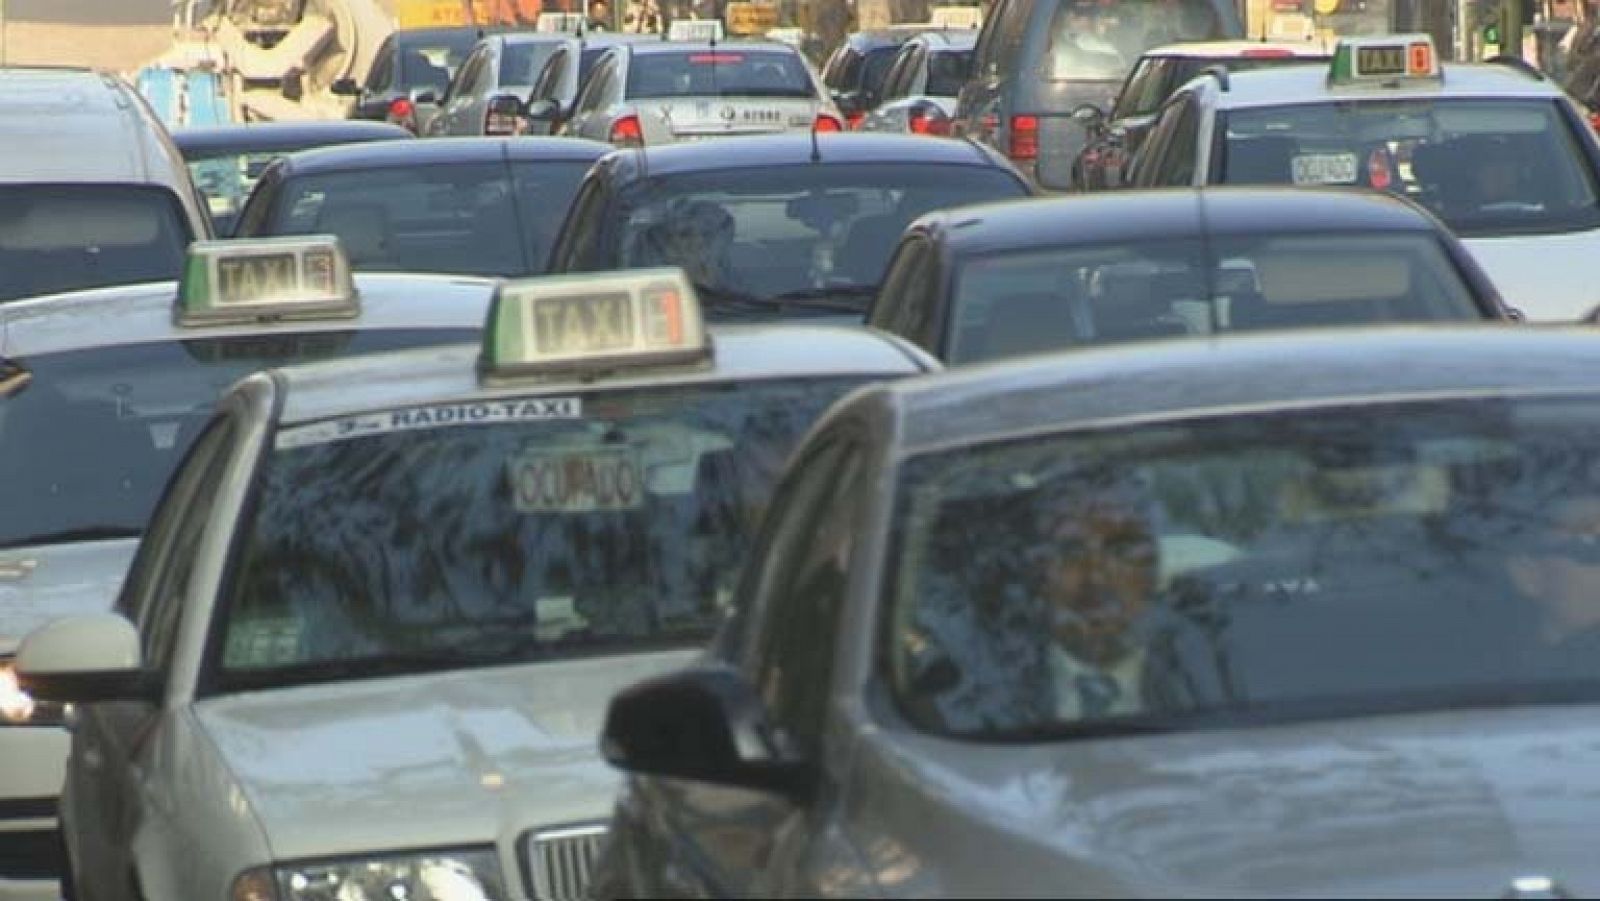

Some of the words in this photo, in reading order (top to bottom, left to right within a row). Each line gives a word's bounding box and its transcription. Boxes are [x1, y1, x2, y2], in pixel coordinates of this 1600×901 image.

[1358, 48, 1403, 74] TAXI
[220, 256, 296, 303] TAXI
[536, 297, 632, 351] TAXI
[391, 400, 571, 428] RADIO-TAXI
[518, 460, 634, 506] OCUPADO
